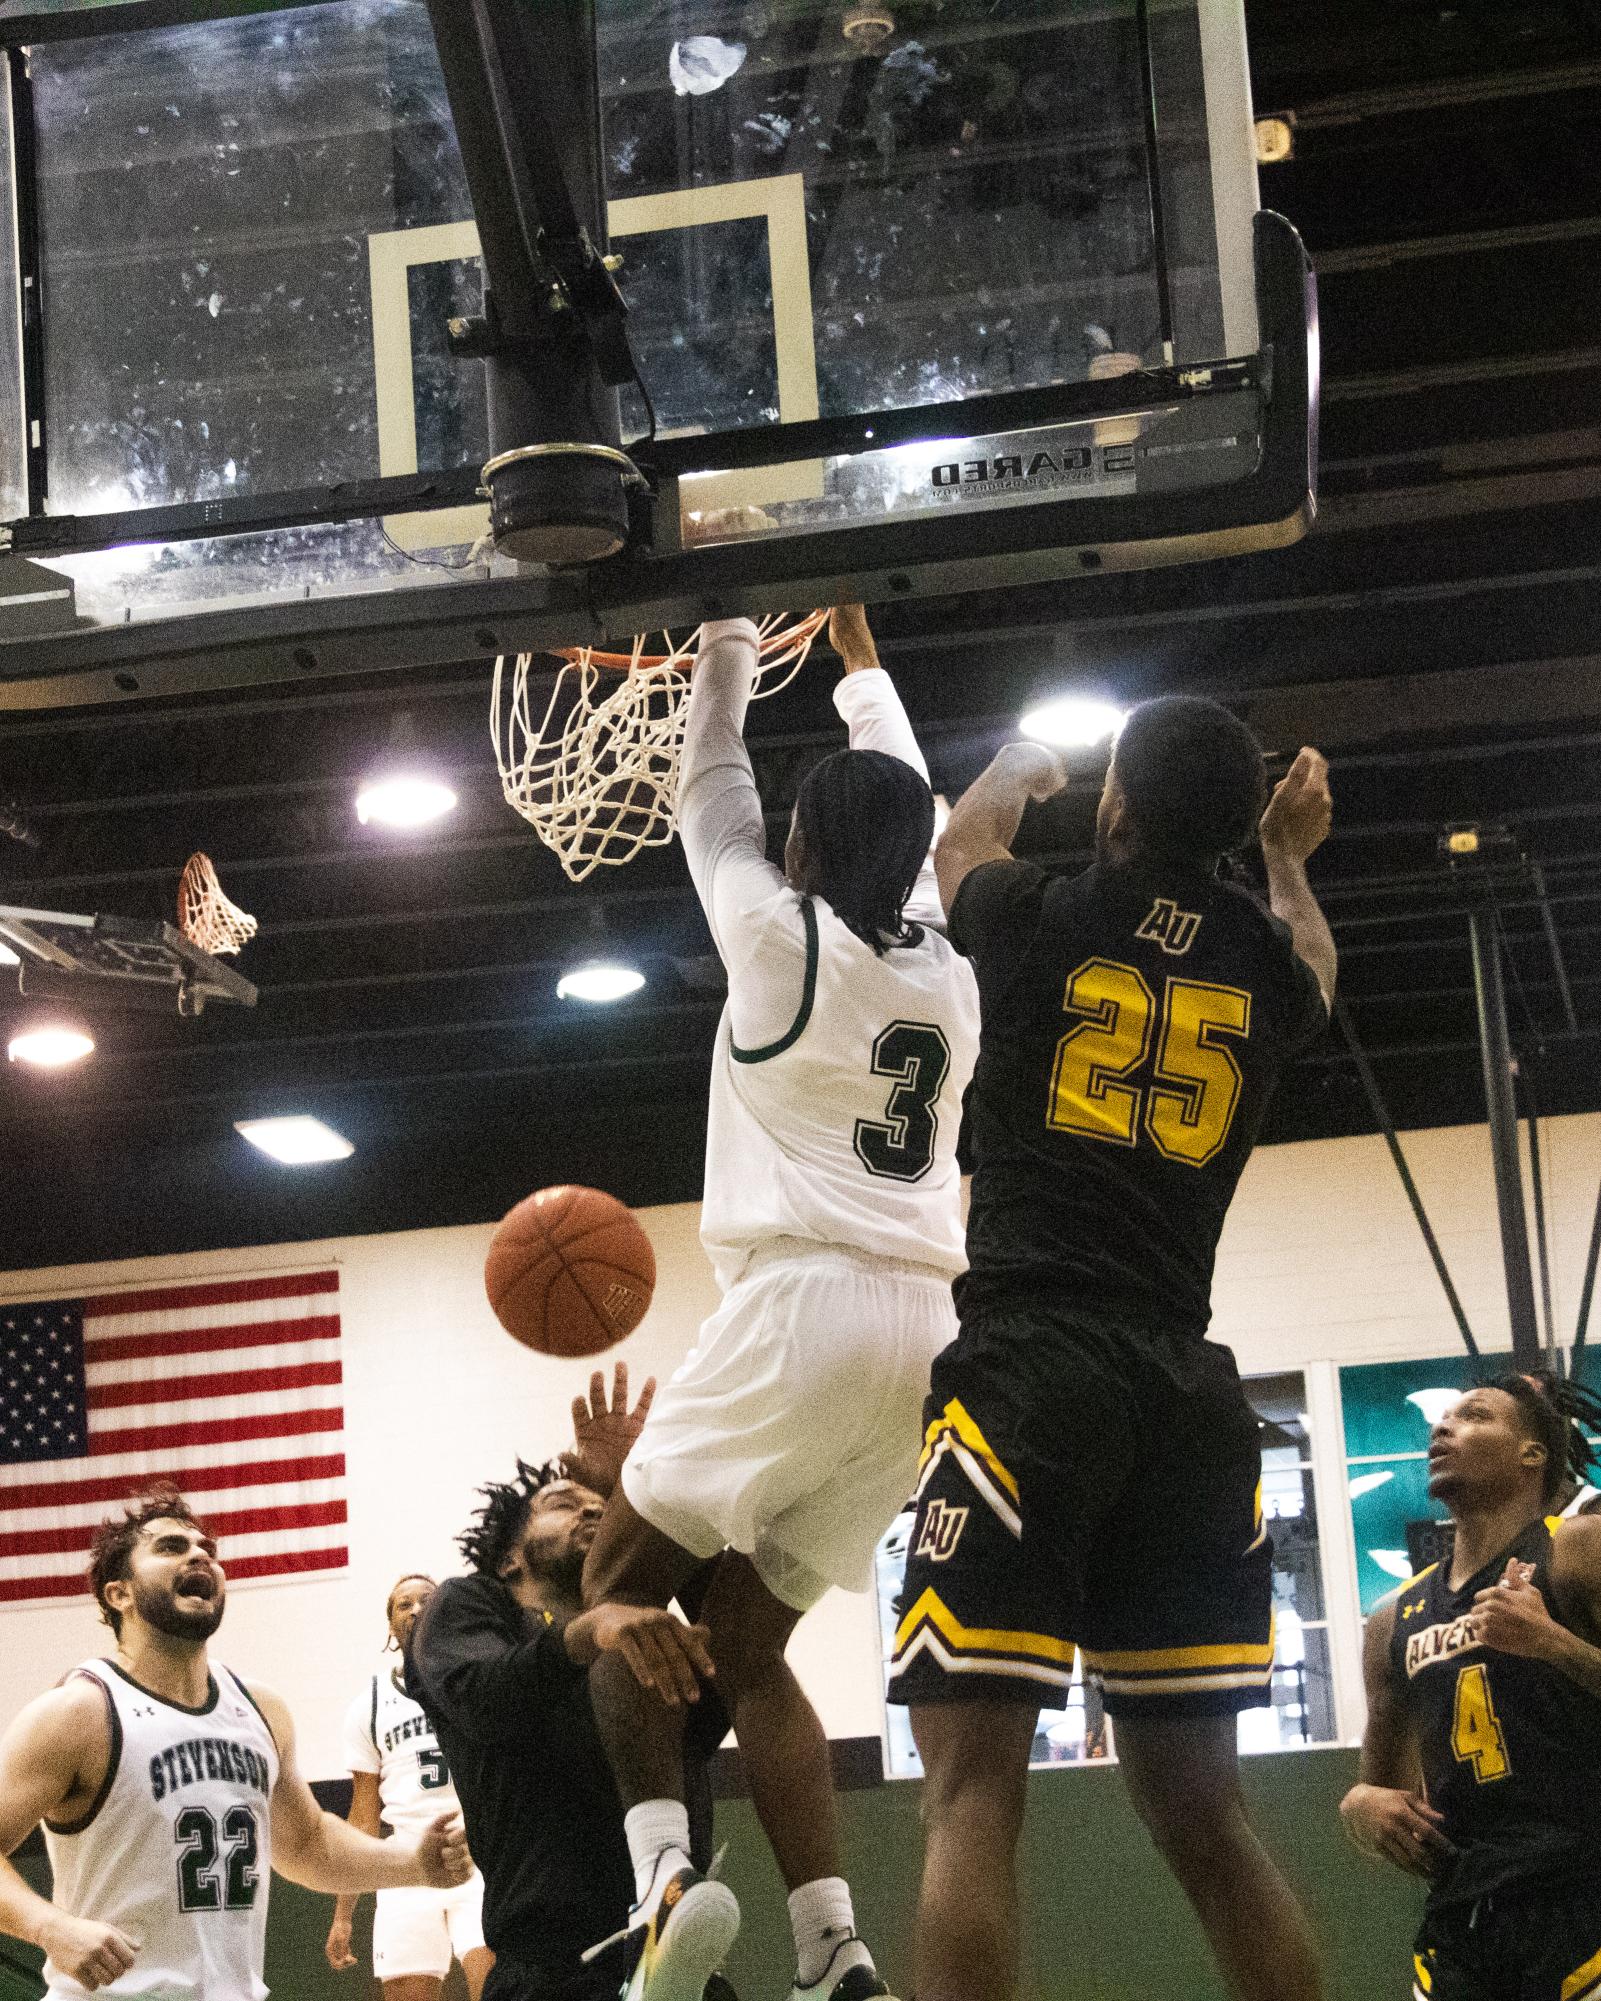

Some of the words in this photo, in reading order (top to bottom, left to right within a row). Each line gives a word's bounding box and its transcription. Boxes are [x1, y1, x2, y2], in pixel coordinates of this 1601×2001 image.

[1134, 897, 1203, 956] AU
[1046, 955, 1252, 1168] 25
[853, 1019, 952, 1184] 3
[914, 1498, 970, 1562] AU
[1406, 1613, 1483, 1680] ALVER
[384, 1714, 437, 1752] STEVE
[1450, 1663, 1513, 1784] 4
[149, 1737, 269, 1802] STEVENSON
[416, 1749, 452, 1791] 5
[174, 1805, 260, 1914] 22
